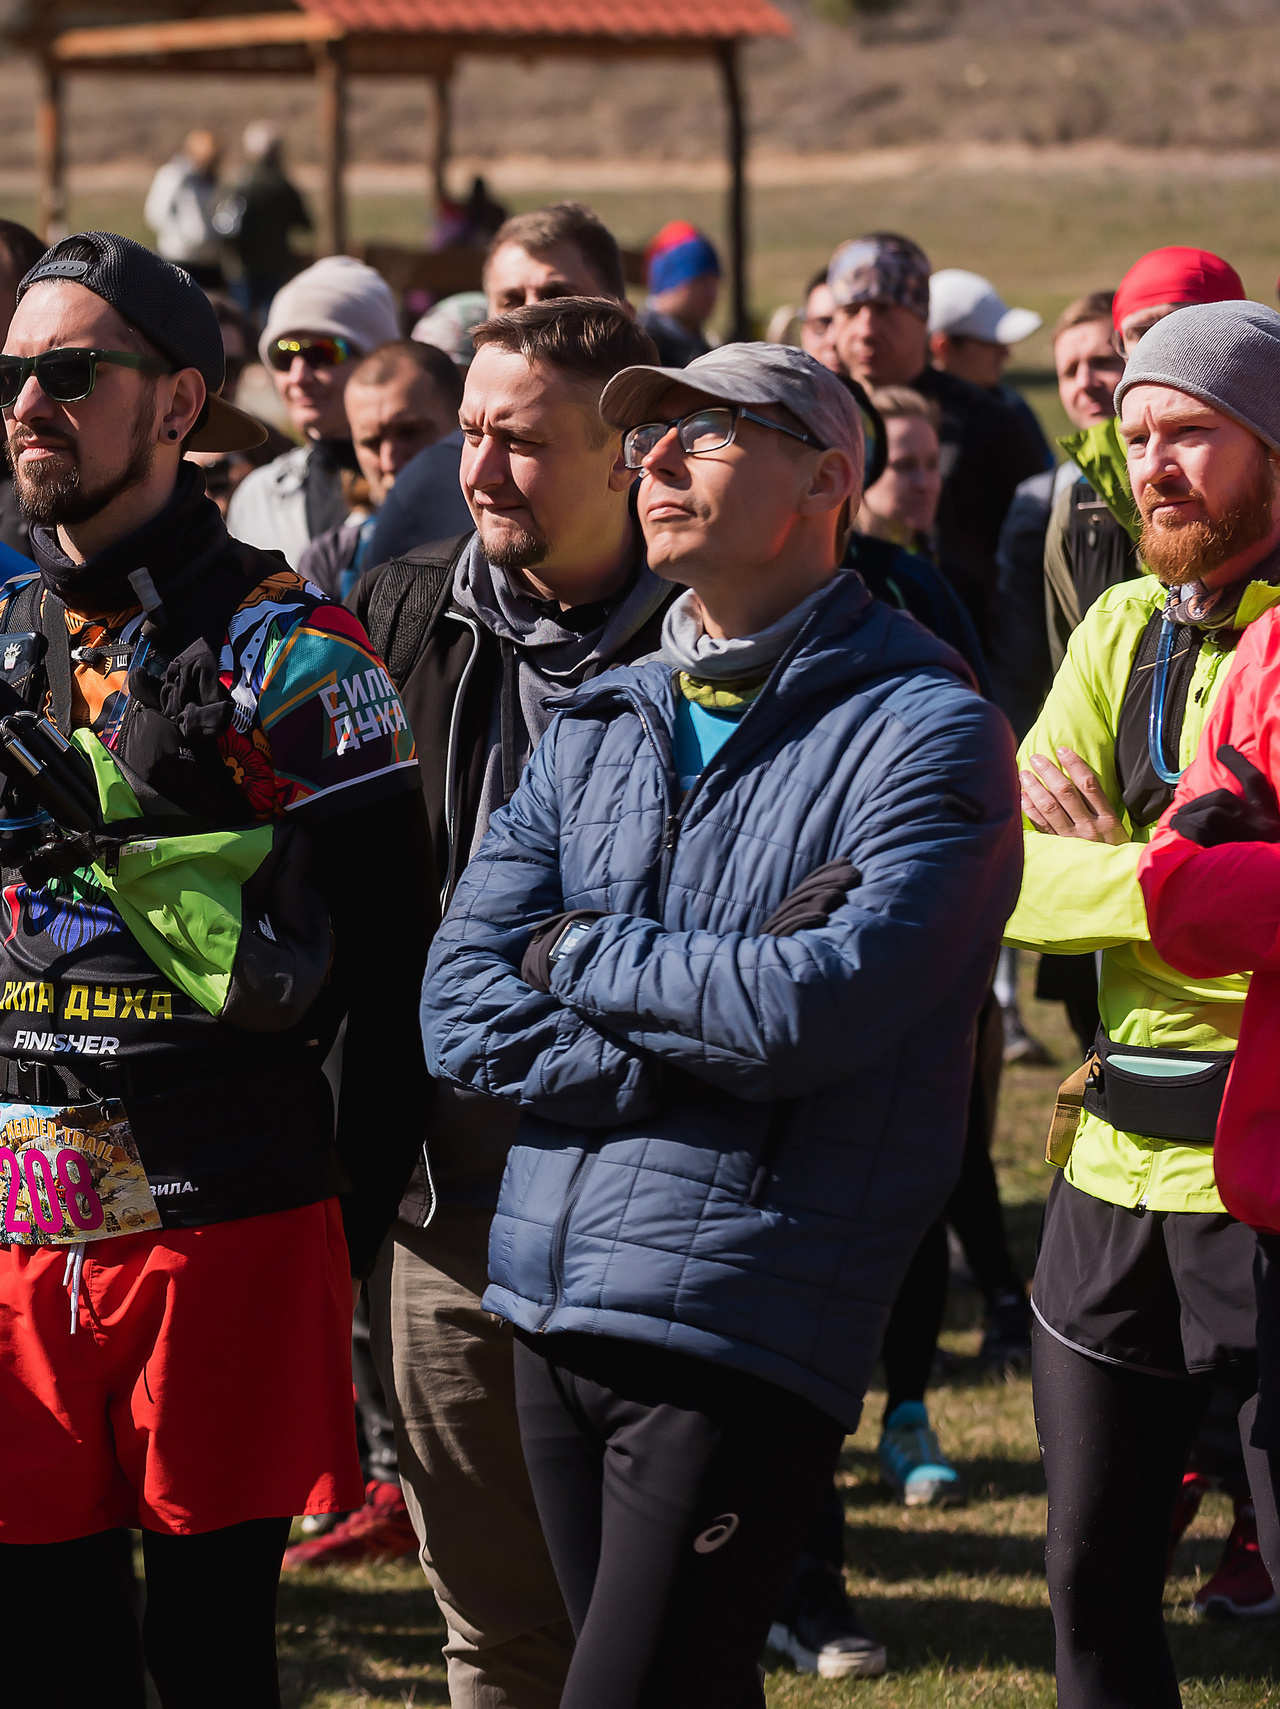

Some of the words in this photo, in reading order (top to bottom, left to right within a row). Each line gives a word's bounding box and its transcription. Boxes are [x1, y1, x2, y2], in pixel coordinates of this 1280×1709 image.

[318, 667, 396, 719] СИЛА
[334, 699, 408, 757] ДУХА
[119, 840, 158, 857] ERS
[64, 984, 173, 1021] ДУХА
[13, 1030, 120, 1056] FINISHER
[62, 1126, 114, 1164] TRAIL
